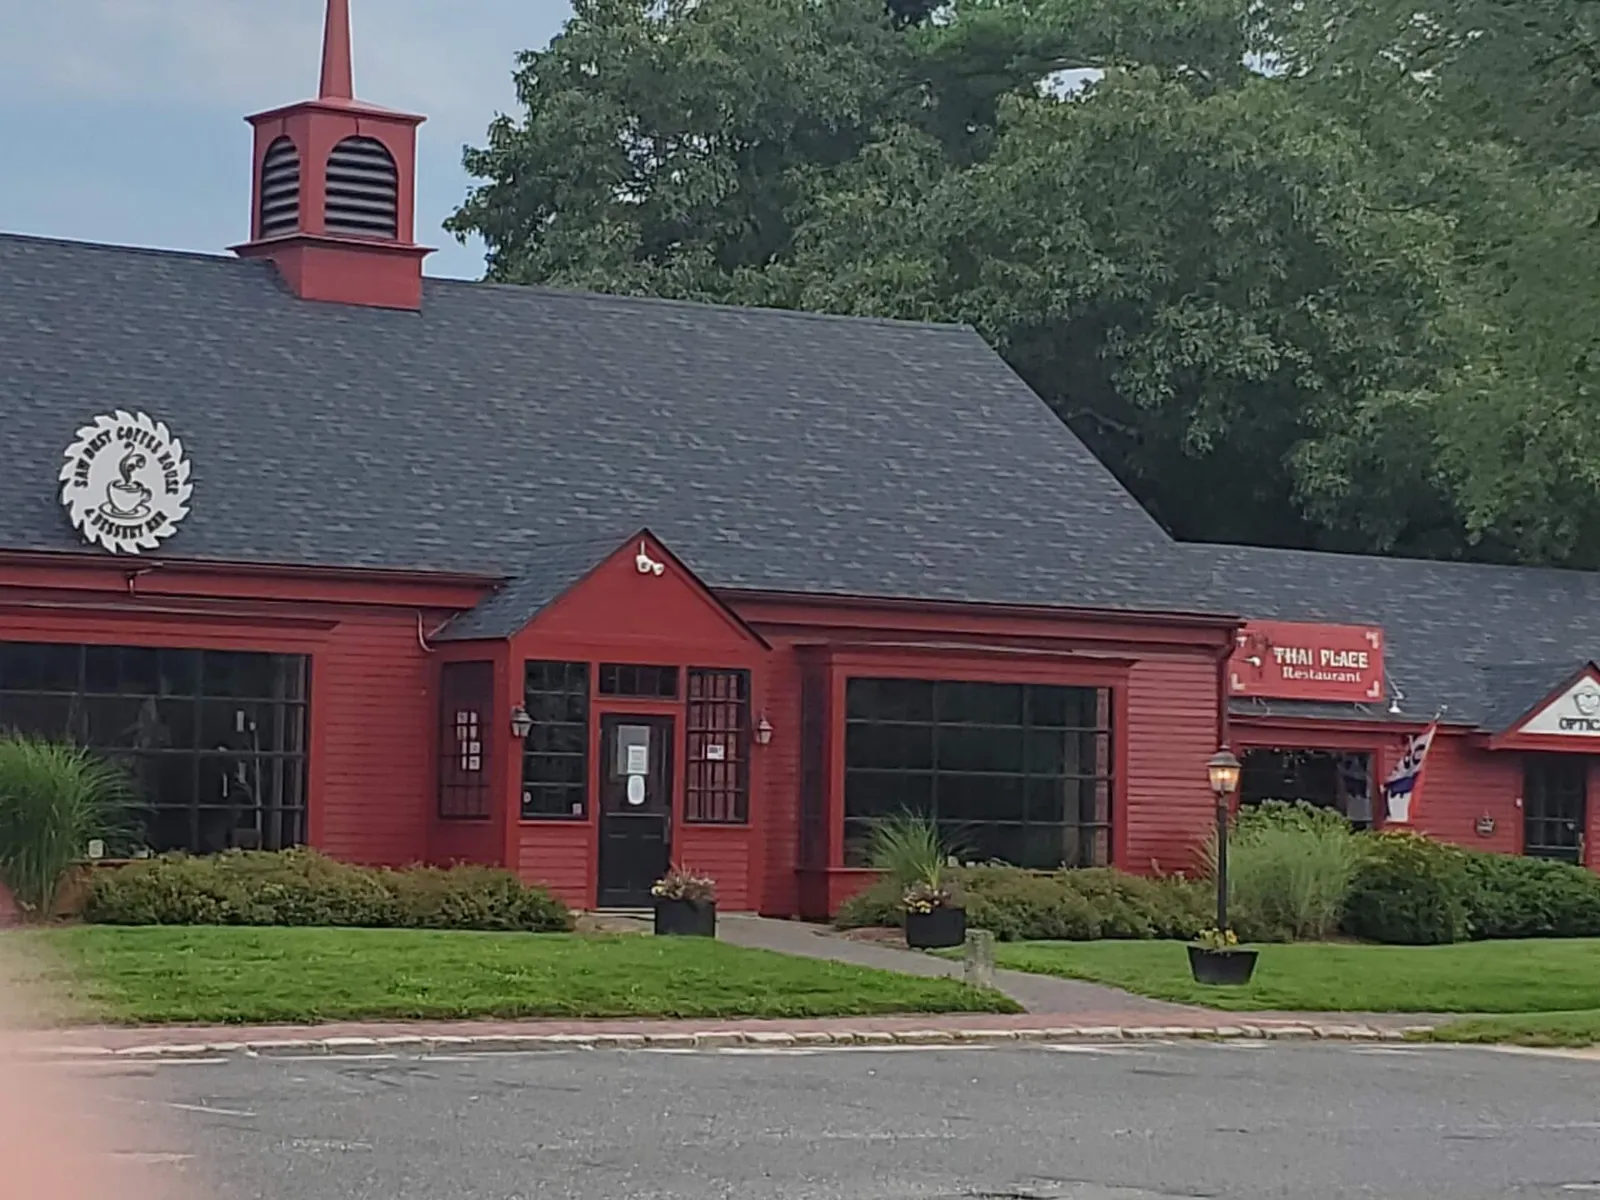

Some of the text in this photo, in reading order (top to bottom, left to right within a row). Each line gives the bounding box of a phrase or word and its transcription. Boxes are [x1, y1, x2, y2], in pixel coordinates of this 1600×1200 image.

[116, 426, 163, 454] COFFEE
[157, 451, 179, 495] HOUSE
[1273, 647, 1369, 668] THAI PLACE
[1282, 666, 1361, 682] Restaurant
